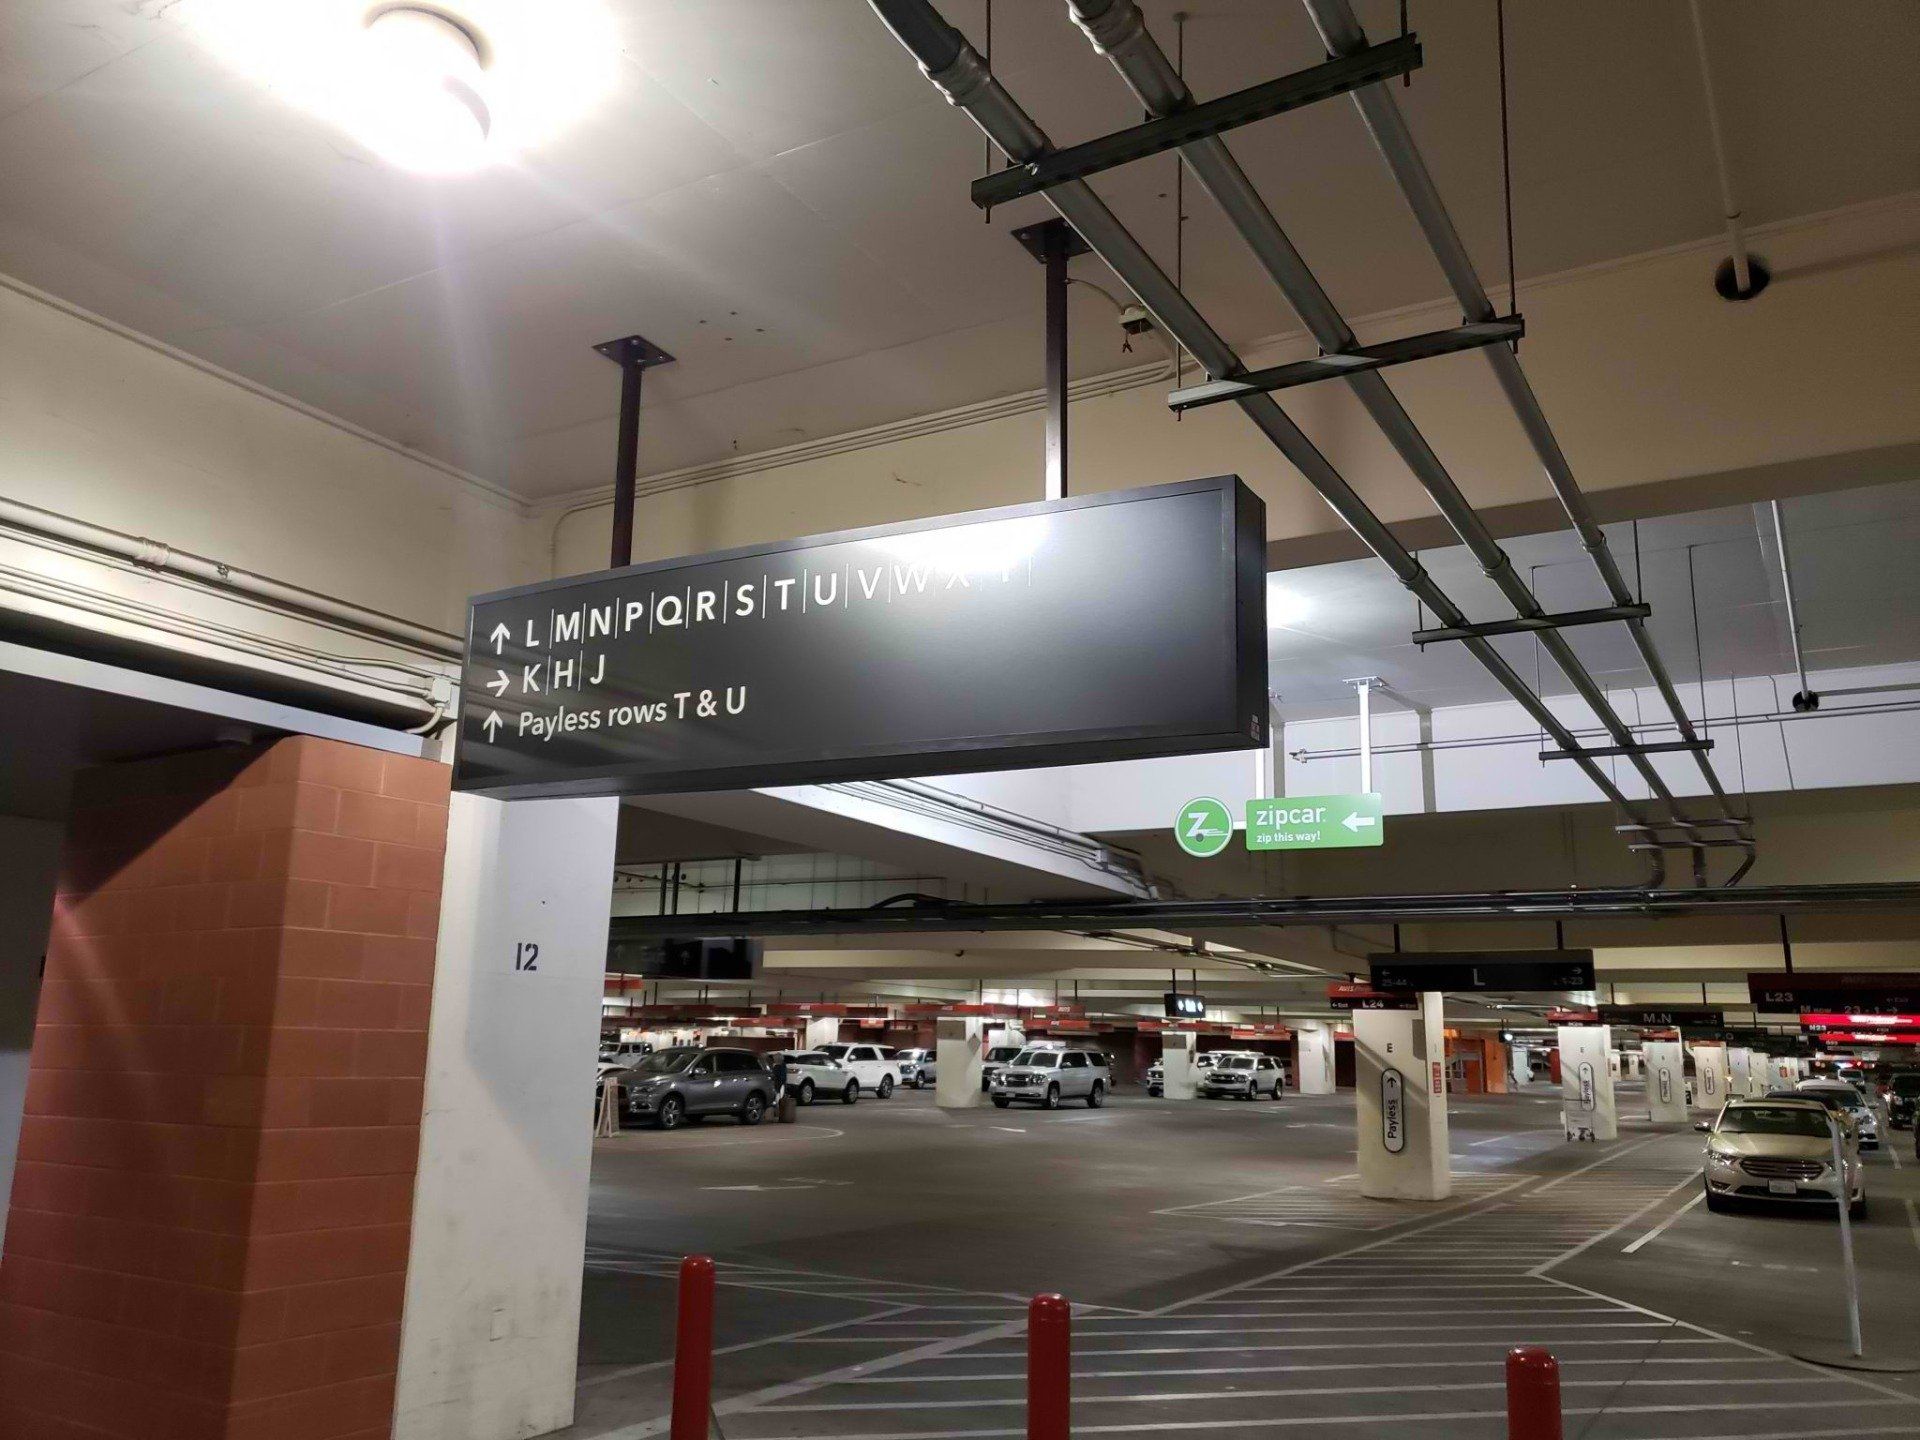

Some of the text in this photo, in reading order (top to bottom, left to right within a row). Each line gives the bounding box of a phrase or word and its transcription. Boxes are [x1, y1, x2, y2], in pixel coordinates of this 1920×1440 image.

[526, 619, 540, 648] L
[555, 611, 580, 643] M
[588, 606, 611, 637] N
[625, 601, 643, 632] P
[656, 595, 683, 626] Q
[696, 590, 716, 622] R
[735, 583, 755, 616] S
[774, 578, 796, 611] T
[814, 573, 837, 606] U
[857, 566, 883, 599] V
[894, 563, 931, 595] W
[521, 654, 605, 694] K H J
[518, 685, 747, 743] Payless rows T & U
[1256, 805, 1327, 830] zipcar
[1256, 830, 1322, 844] zip this way!
[515, 942, 539, 971] 12
[1472, 968, 1486, 987] L
[1362, 1000, 1384, 1009] L24
[1765, 992, 1794, 1003] L23
[1387, 1100, 1399, 1139] Payless
